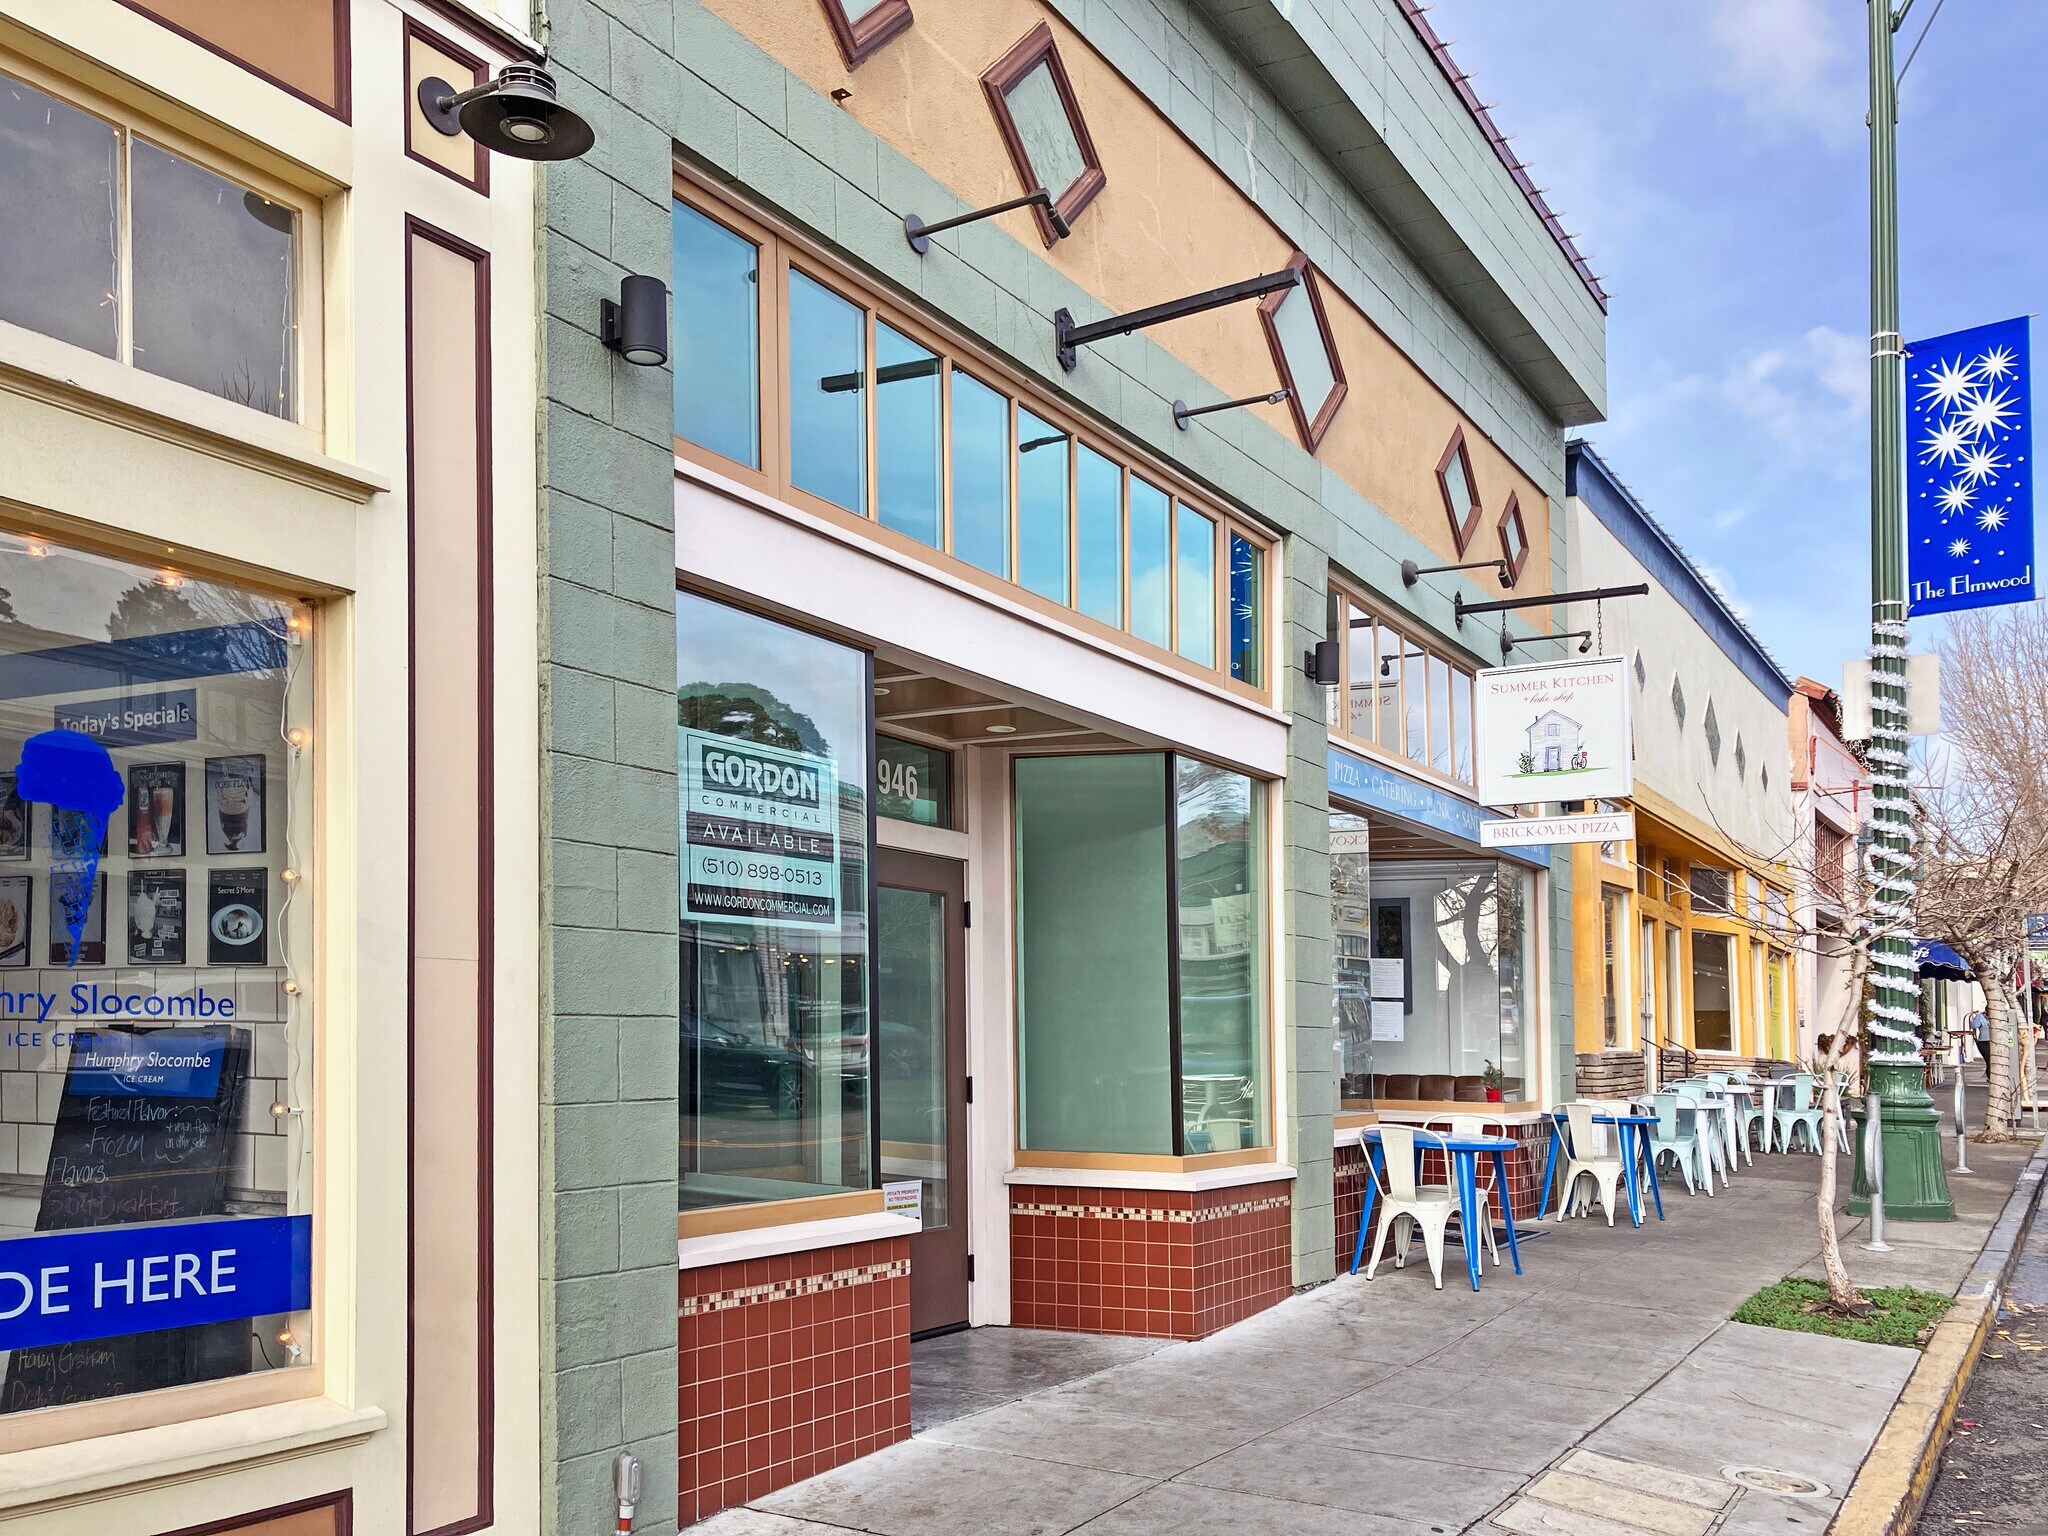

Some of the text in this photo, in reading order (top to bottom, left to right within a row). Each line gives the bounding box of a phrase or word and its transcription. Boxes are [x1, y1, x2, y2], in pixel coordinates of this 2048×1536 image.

[1912, 564, 2031, 601] The Elmwood
[1491, 673, 1614, 695] SUMMER KITCHEN
[1529, 692, 1552, 704] bake
[1552, 691, 1575, 703] shop
[61, 704, 190, 735] Today's Specials
[705, 751, 817, 801] GORDON
[877, 758, 919, 800] 946
[1334, 761, 1361, 788] PIZZA
[1371, 775, 1417, 808] CATERING
[1426, 796, 1454, 823] PICNIC
[701, 795, 821, 824] COMMERCIAL
[703, 822, 820, 854] AVAILABLE
[1493, 821, 1620, 839] BRICK-OVEN PIZZA
[701, 856, 823, 886] (510) 898-0513
[217, 887, 235, 895] Secret
[694, 892, 830, 917] WWW.GORDONCOMMERCIAL.COM
[70, 984, 235, 1018] Slocombe
[7, 1033, 42, 1047] ICE
[85, 1051, 211, 1072] Humphry Slocombe
[123, 1075, 164, 1083] ICE CREAM
[89, 1125, 146, 1162] Frozen
[93, 1248, 237, 1309] HERE
